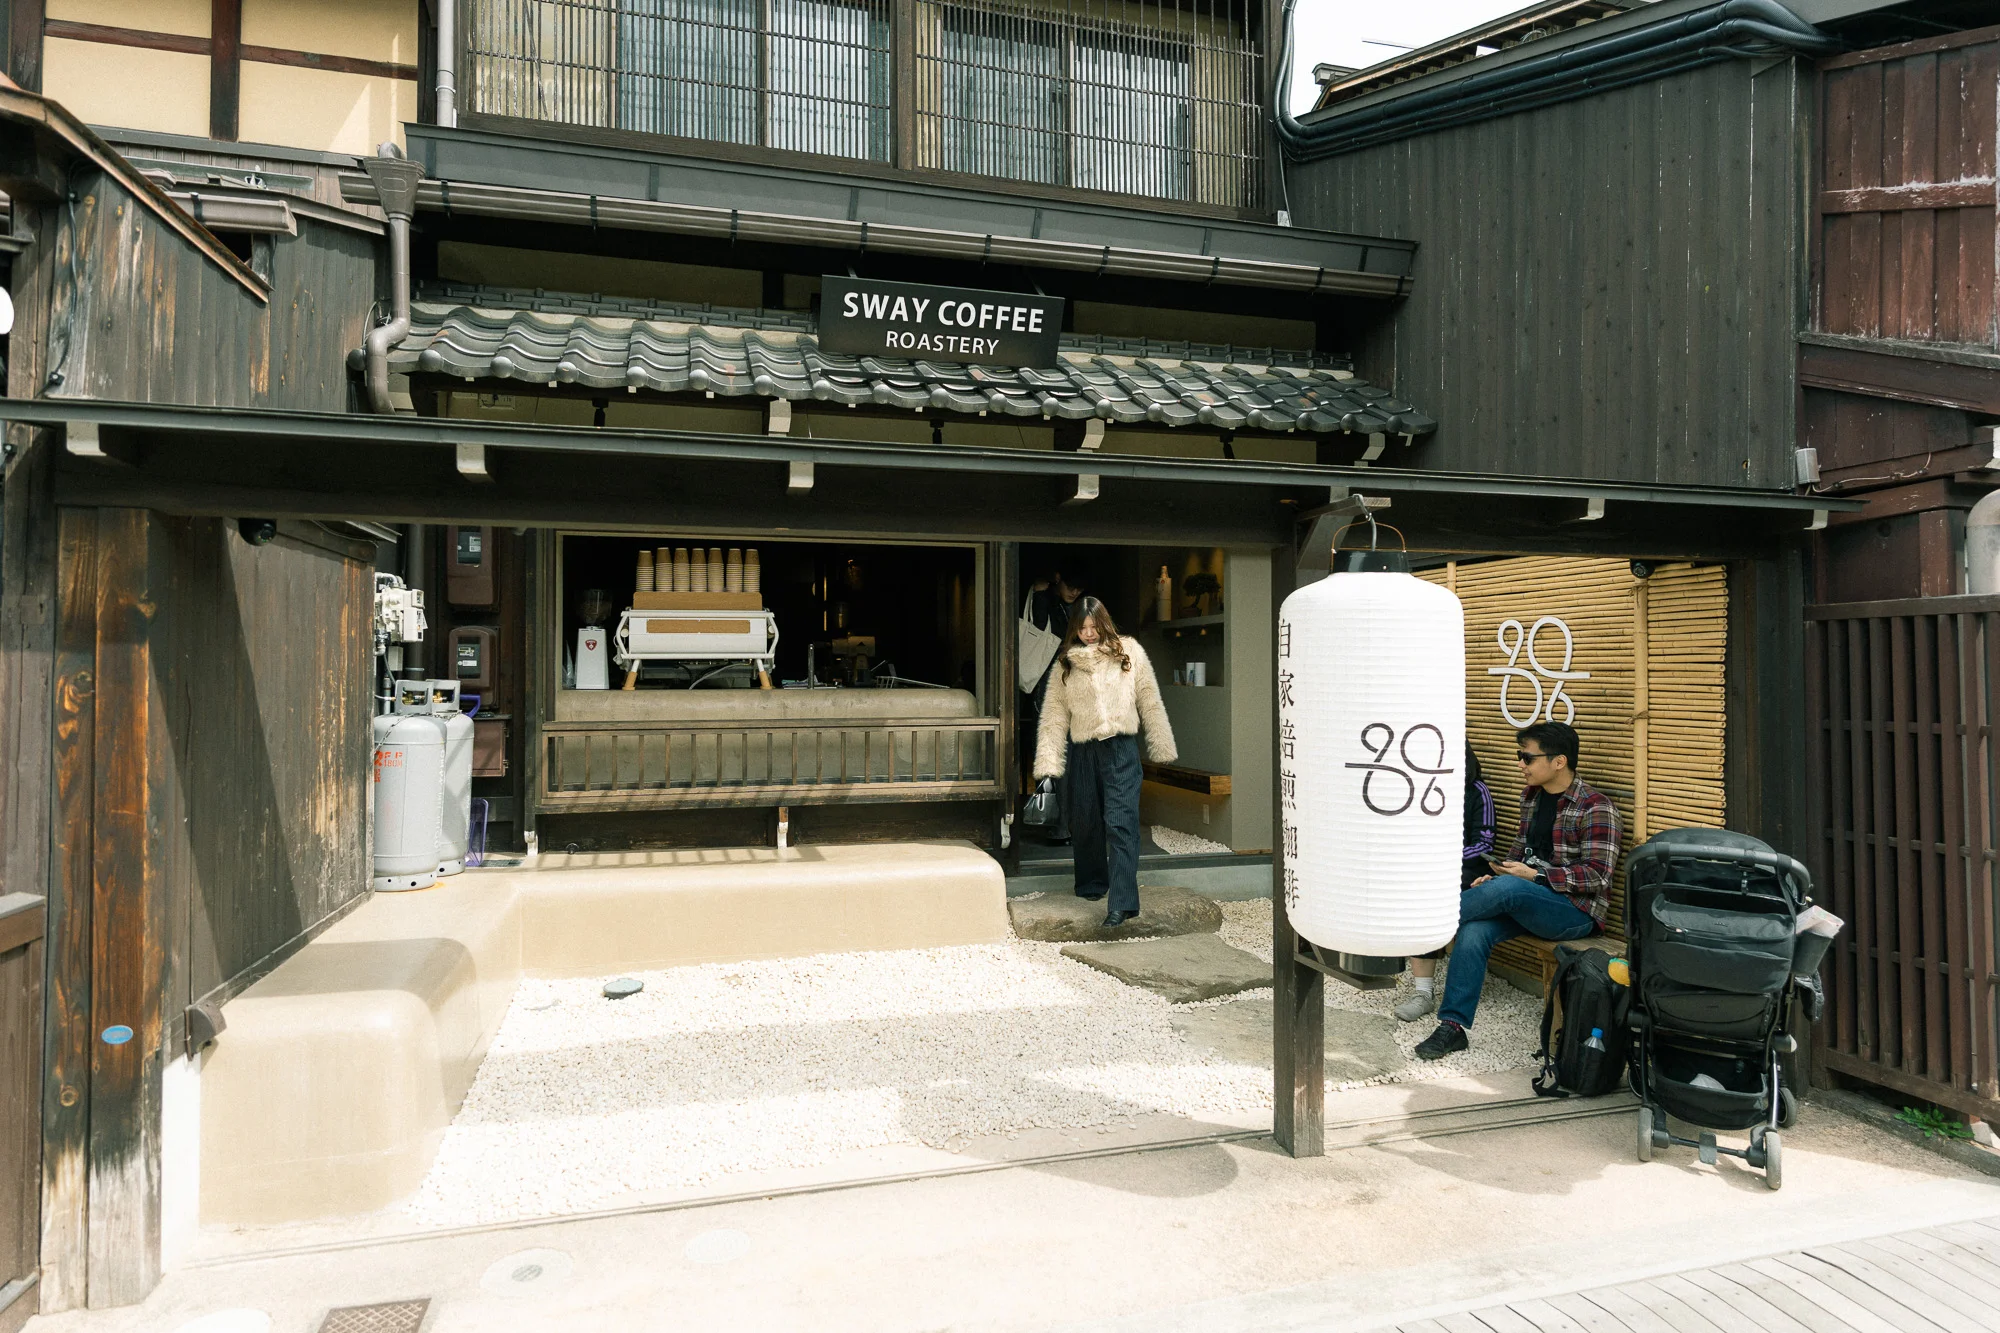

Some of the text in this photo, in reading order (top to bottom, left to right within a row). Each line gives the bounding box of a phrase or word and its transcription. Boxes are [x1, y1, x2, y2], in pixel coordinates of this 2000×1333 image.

[843, 291, 1045, 334] SWAY COFFEE
[885, 330, 1000, 356] ROASTERY
